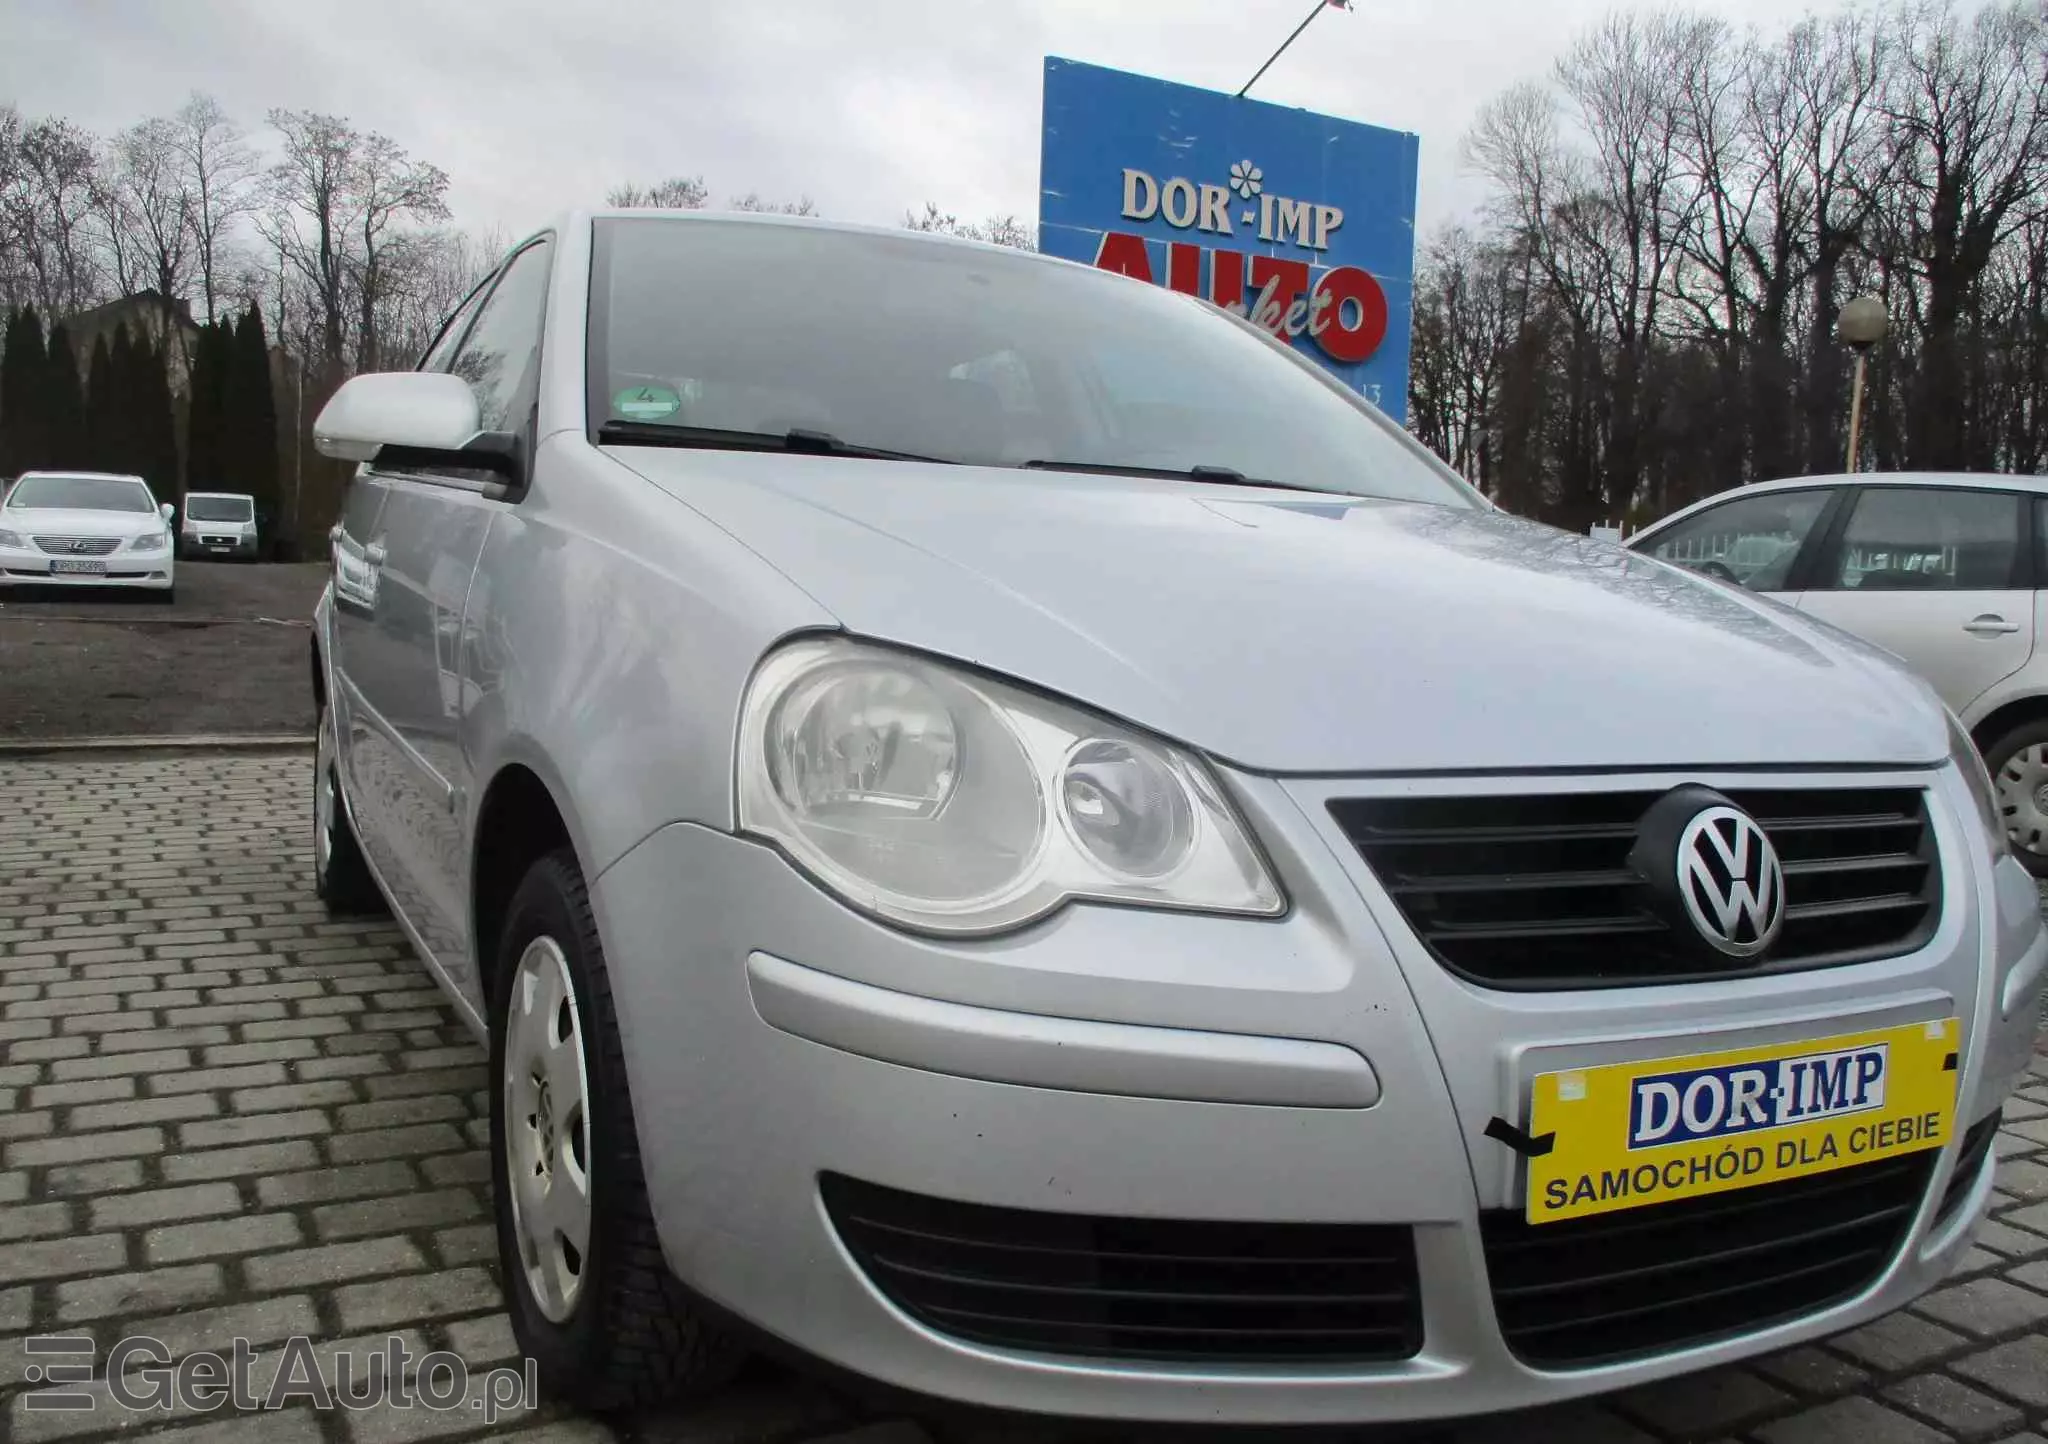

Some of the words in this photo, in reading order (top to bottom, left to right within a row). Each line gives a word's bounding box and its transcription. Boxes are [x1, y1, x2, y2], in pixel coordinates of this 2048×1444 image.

[1121, 168, 1344, 250] DOR-IMP
[1634, 1050, 1884, 1142] DOR-IMP
[1544, 1144, 1765, 1210] SAMOCHÓD
[1775, 1132, 1839, 1170] DLA
[1848, 1112, 1941, 1154] CIEBIE
